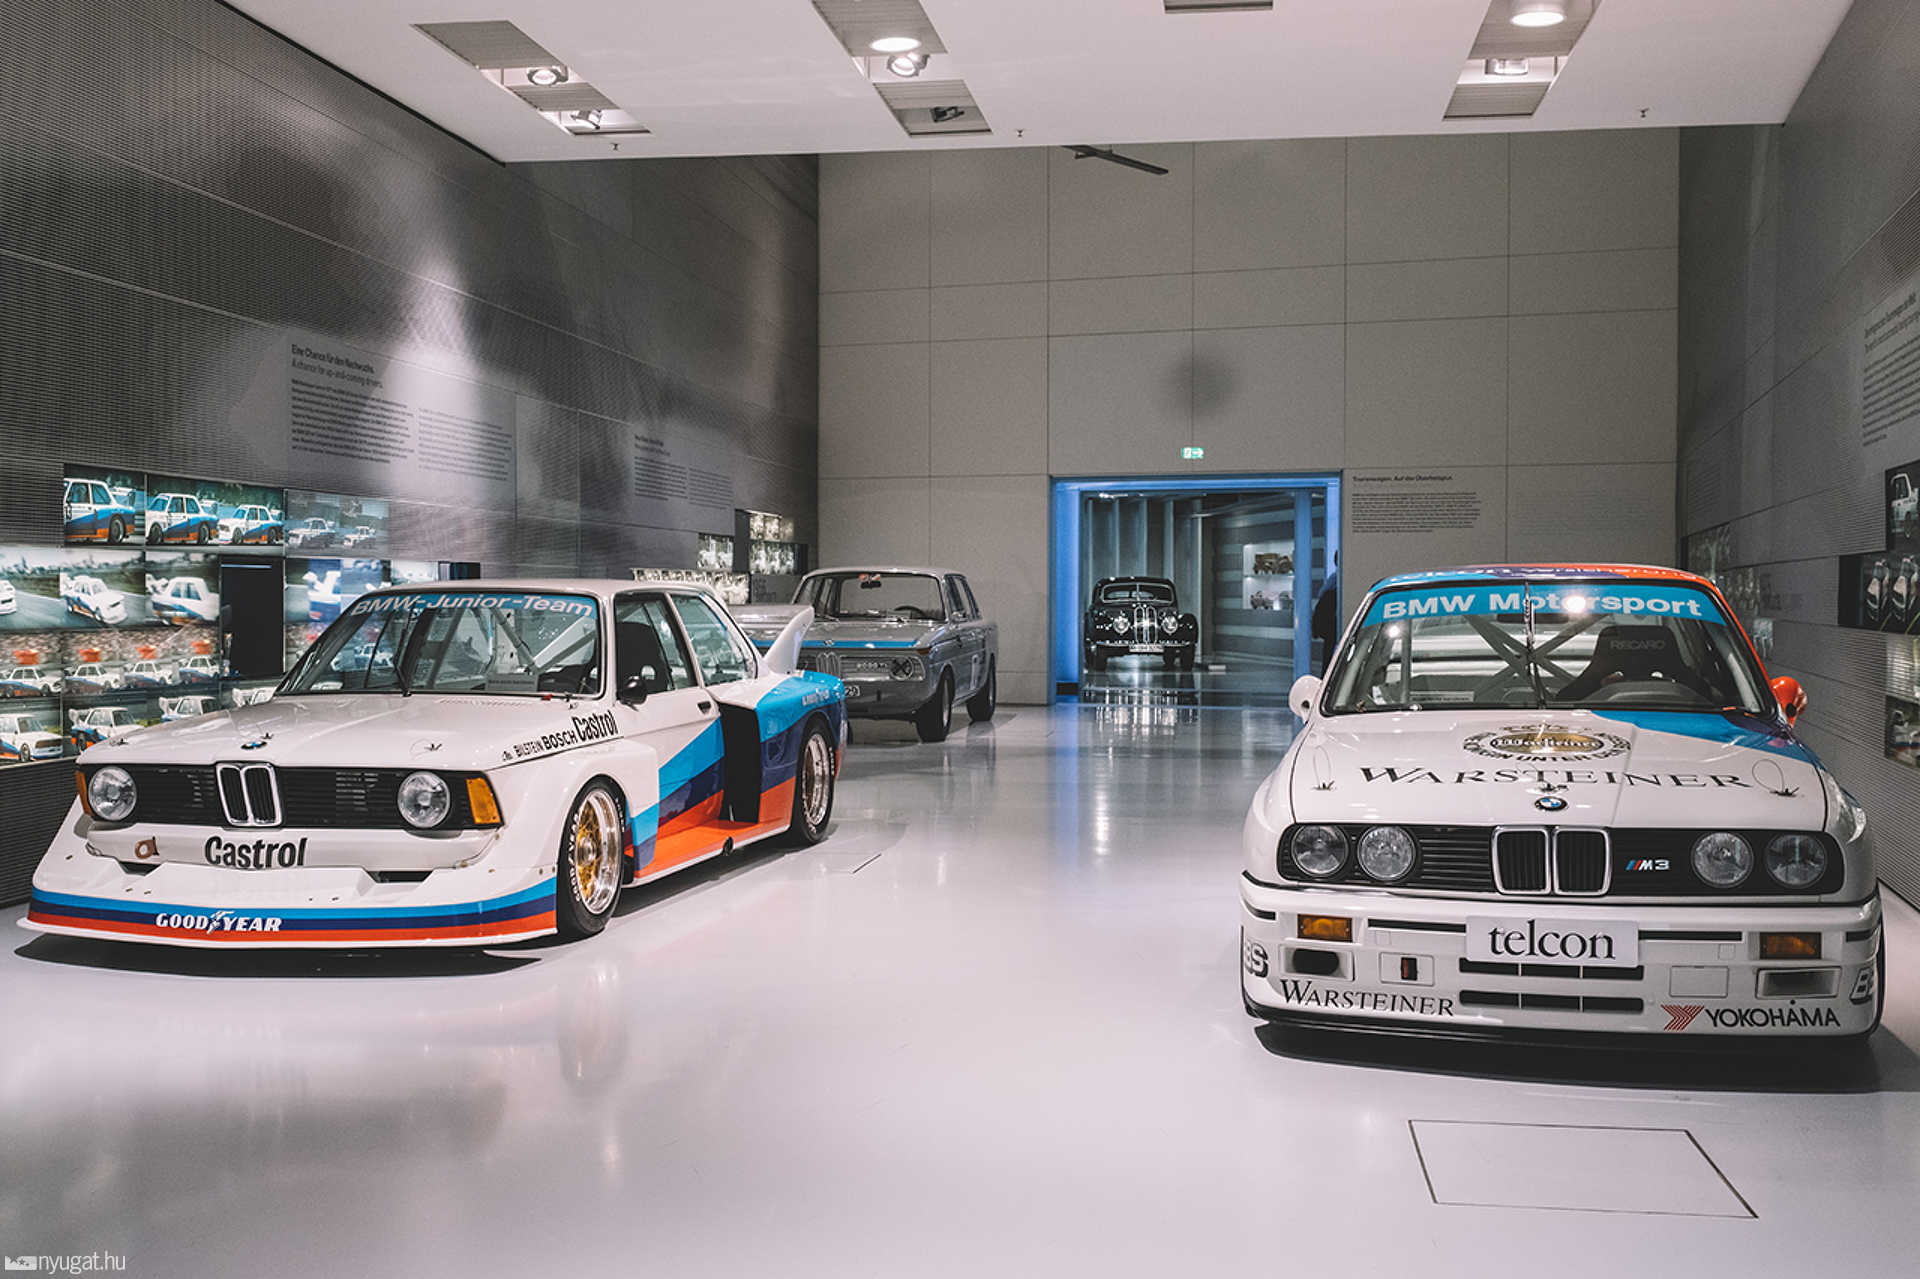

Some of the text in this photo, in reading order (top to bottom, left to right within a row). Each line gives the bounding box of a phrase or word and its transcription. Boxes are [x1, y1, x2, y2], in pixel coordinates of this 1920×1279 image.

[350, 594, 593, 616] BMW-Junior-Team
[1383, 594, 1476, 619] BMW
[541, 729, 579, 750] BOSCH
[571, 709, 619, 742] Castrol
[1360, 767, 1753, 788] WARSTEINER
[204, 836, 308, 869] Castrol
[155, 911, 283, 933] GOODYEAR
[1488, 919, 1616, 960] telcon
[1280, 979, 1454, 1017] WARSTEINER
[1704, 1007, 1841, 1028] YOKOHAMA
